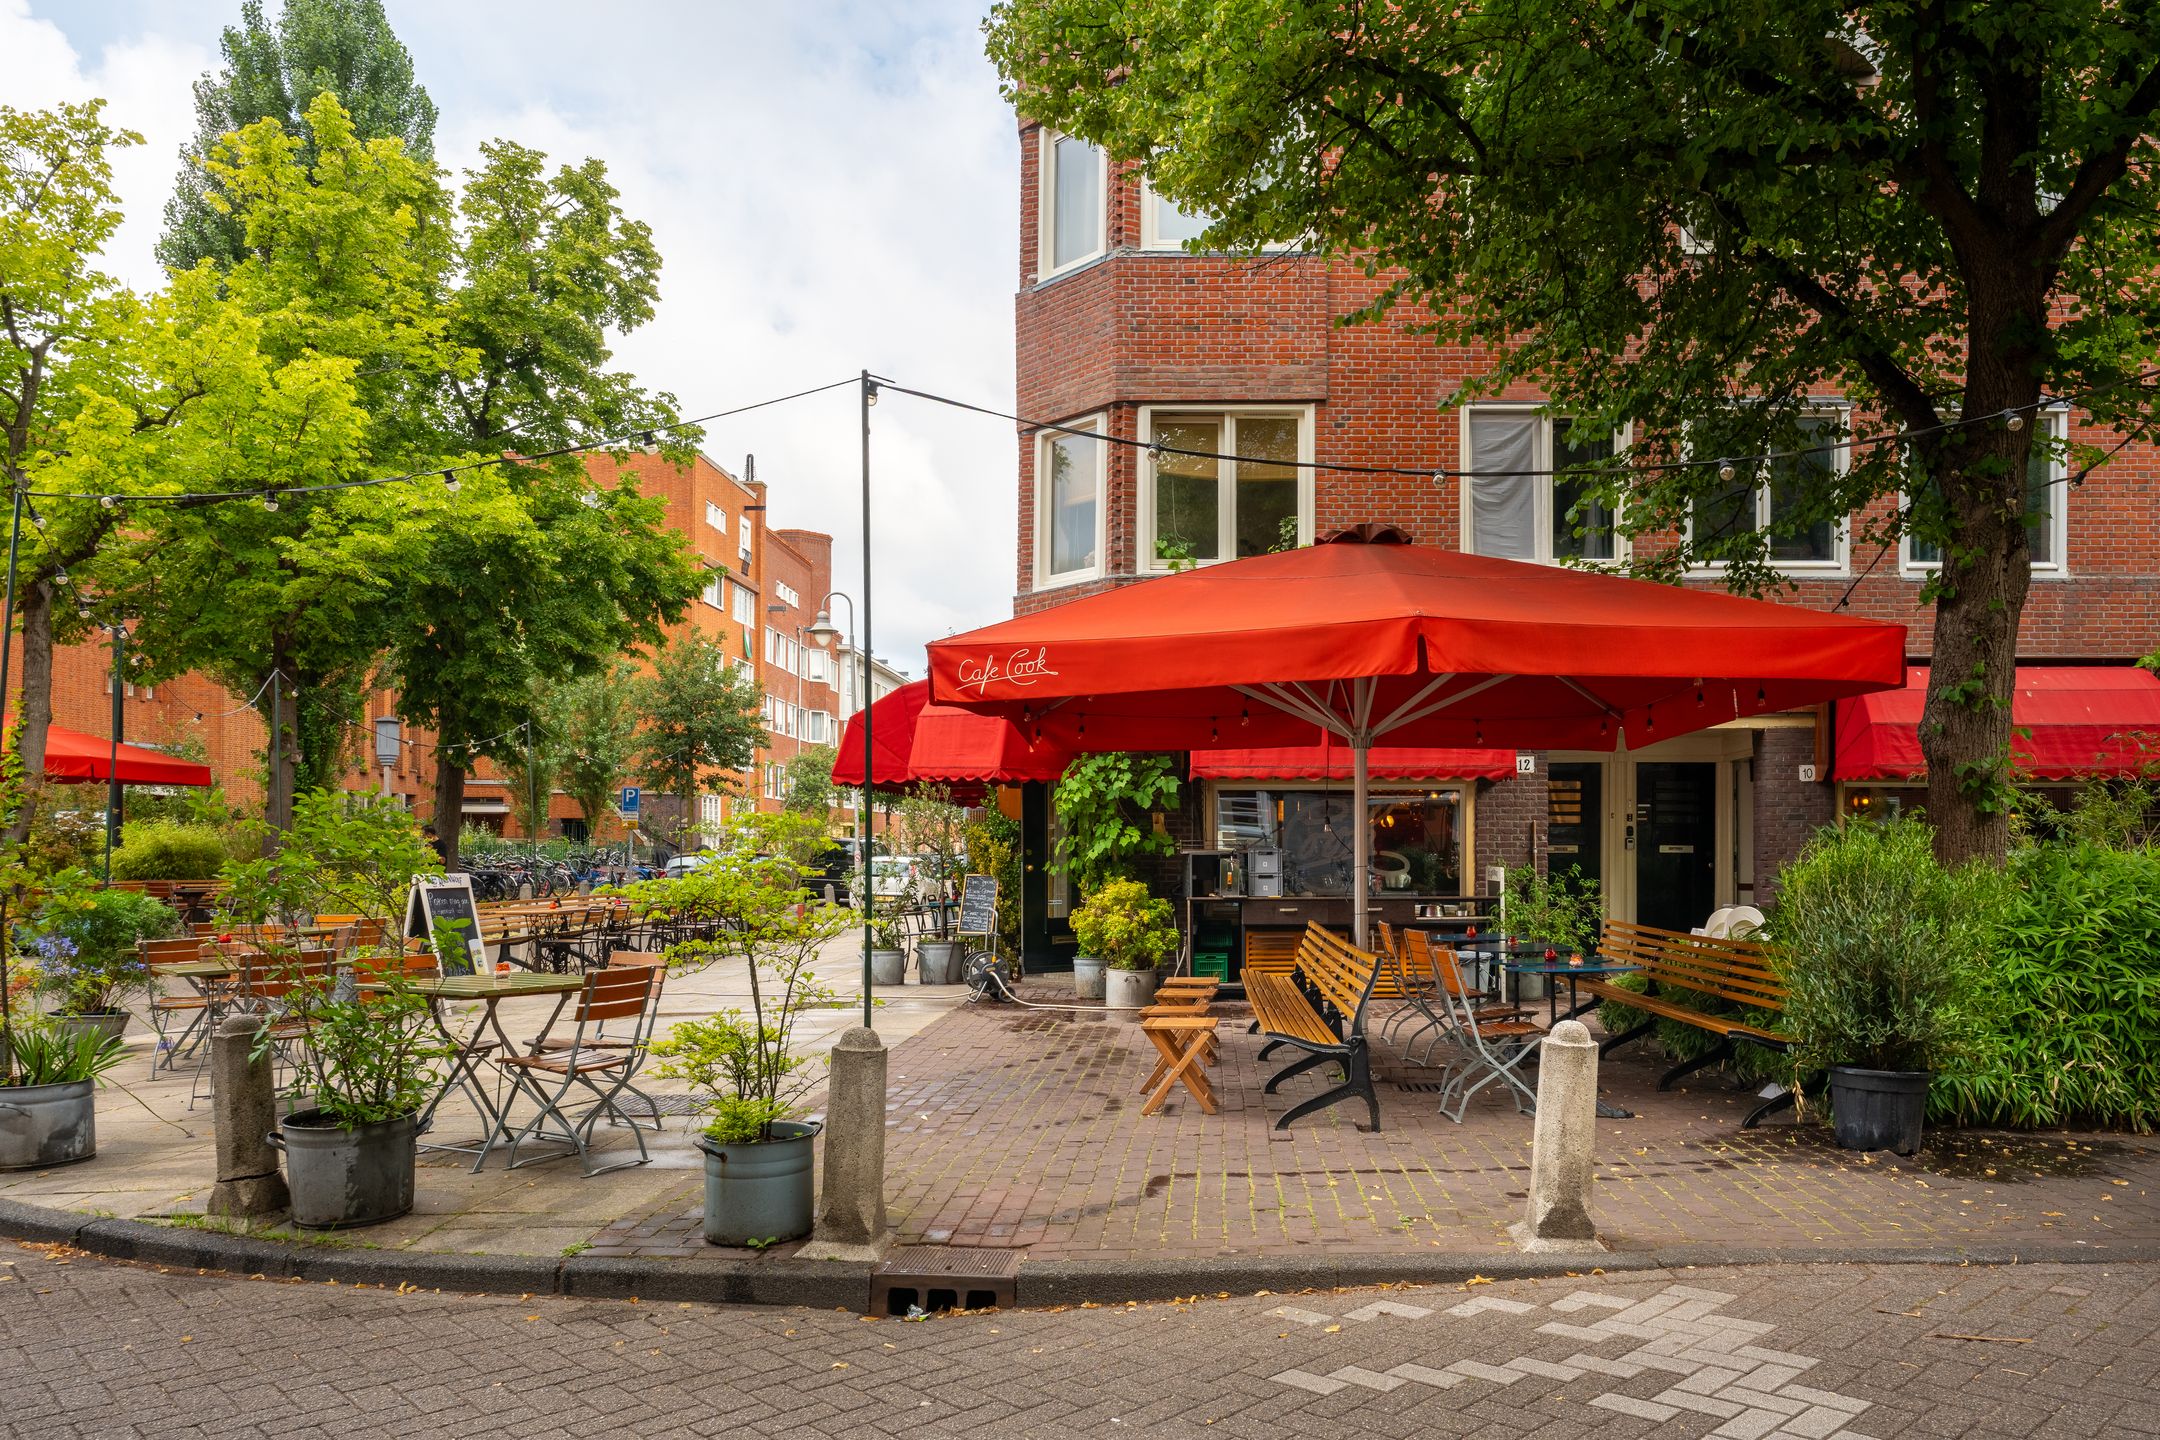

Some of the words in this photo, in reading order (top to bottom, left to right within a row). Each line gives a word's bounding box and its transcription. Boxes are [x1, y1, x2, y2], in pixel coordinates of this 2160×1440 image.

[958, 654, 999, 695] Cafe
[1006, 646, 1058, 686] Cook
[1518, 758, 1531, 771] 12
[1802, 767, 1813, 779] 10
[626, 789, 636, 802] P
